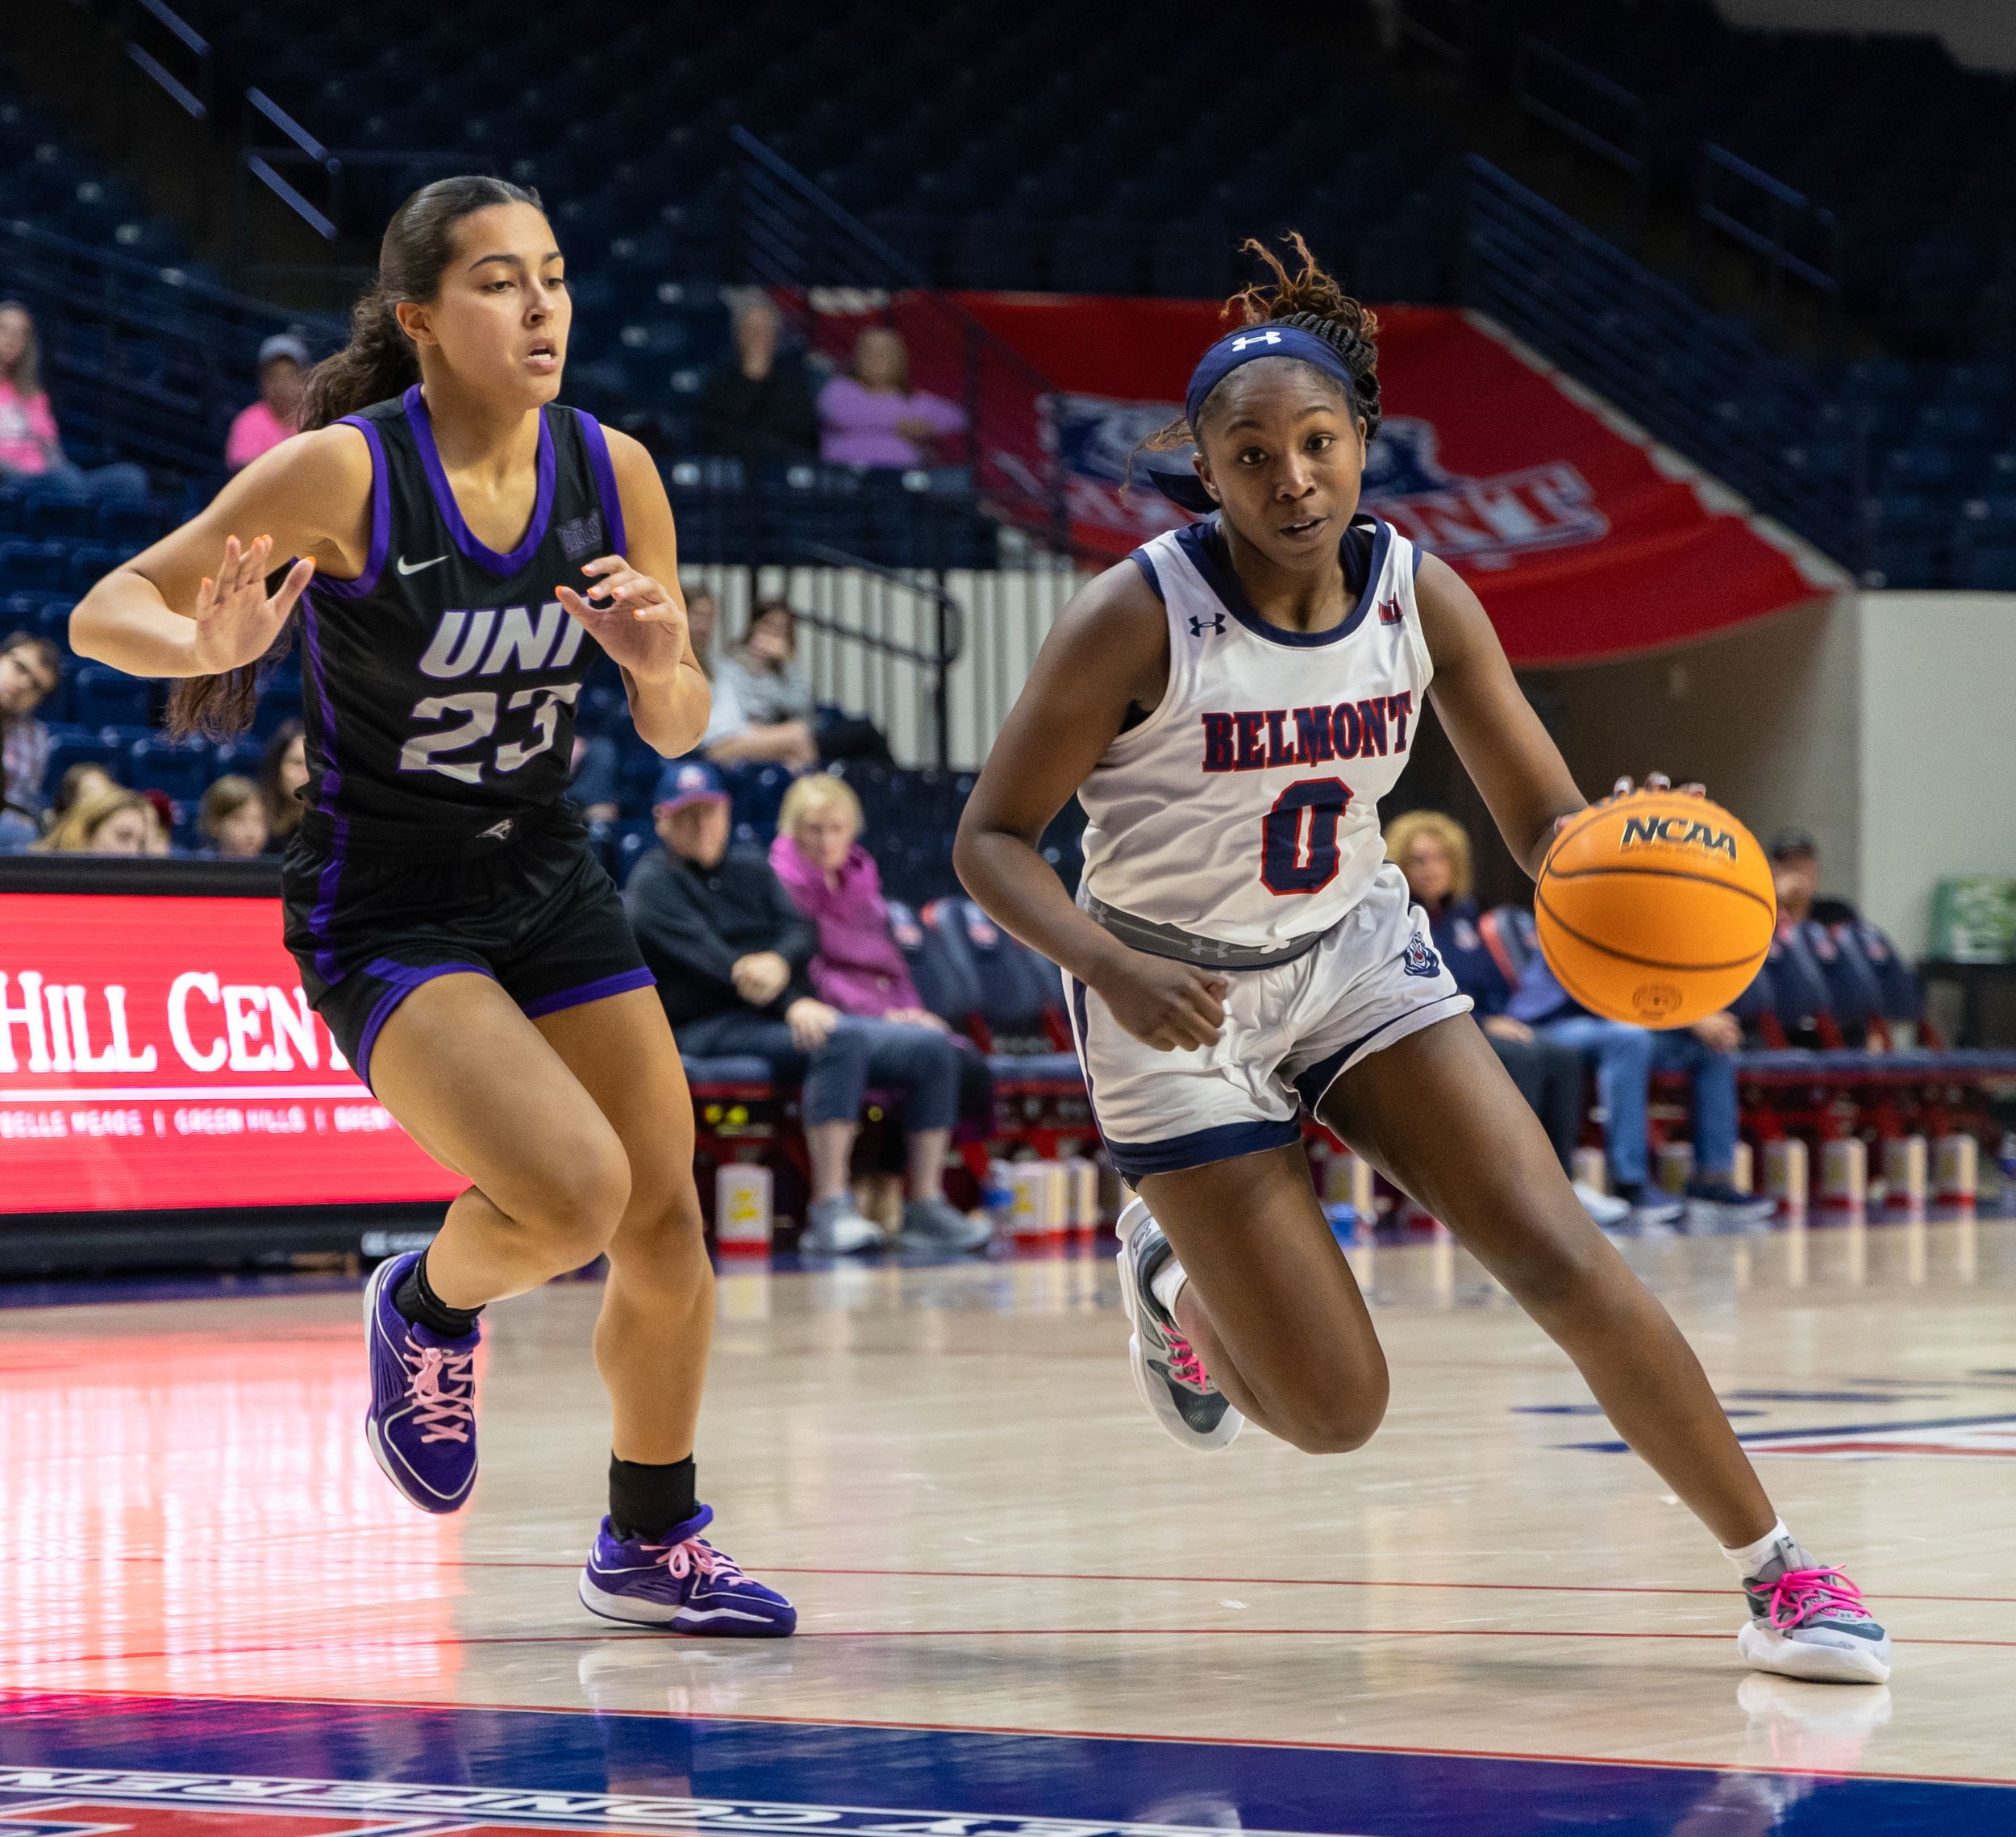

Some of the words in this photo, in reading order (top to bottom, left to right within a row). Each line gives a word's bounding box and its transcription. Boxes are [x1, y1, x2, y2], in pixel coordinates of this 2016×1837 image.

[418, 596, 589, 680] UNI
[398, 683, 582, 785] 23
[1202, 690, 1413, 773] BELMONT
[1259, 777, 1354, 896] 0
[1618, 814, 1738, 863] NCAA
[0, 971, 158, 1073] HILL
